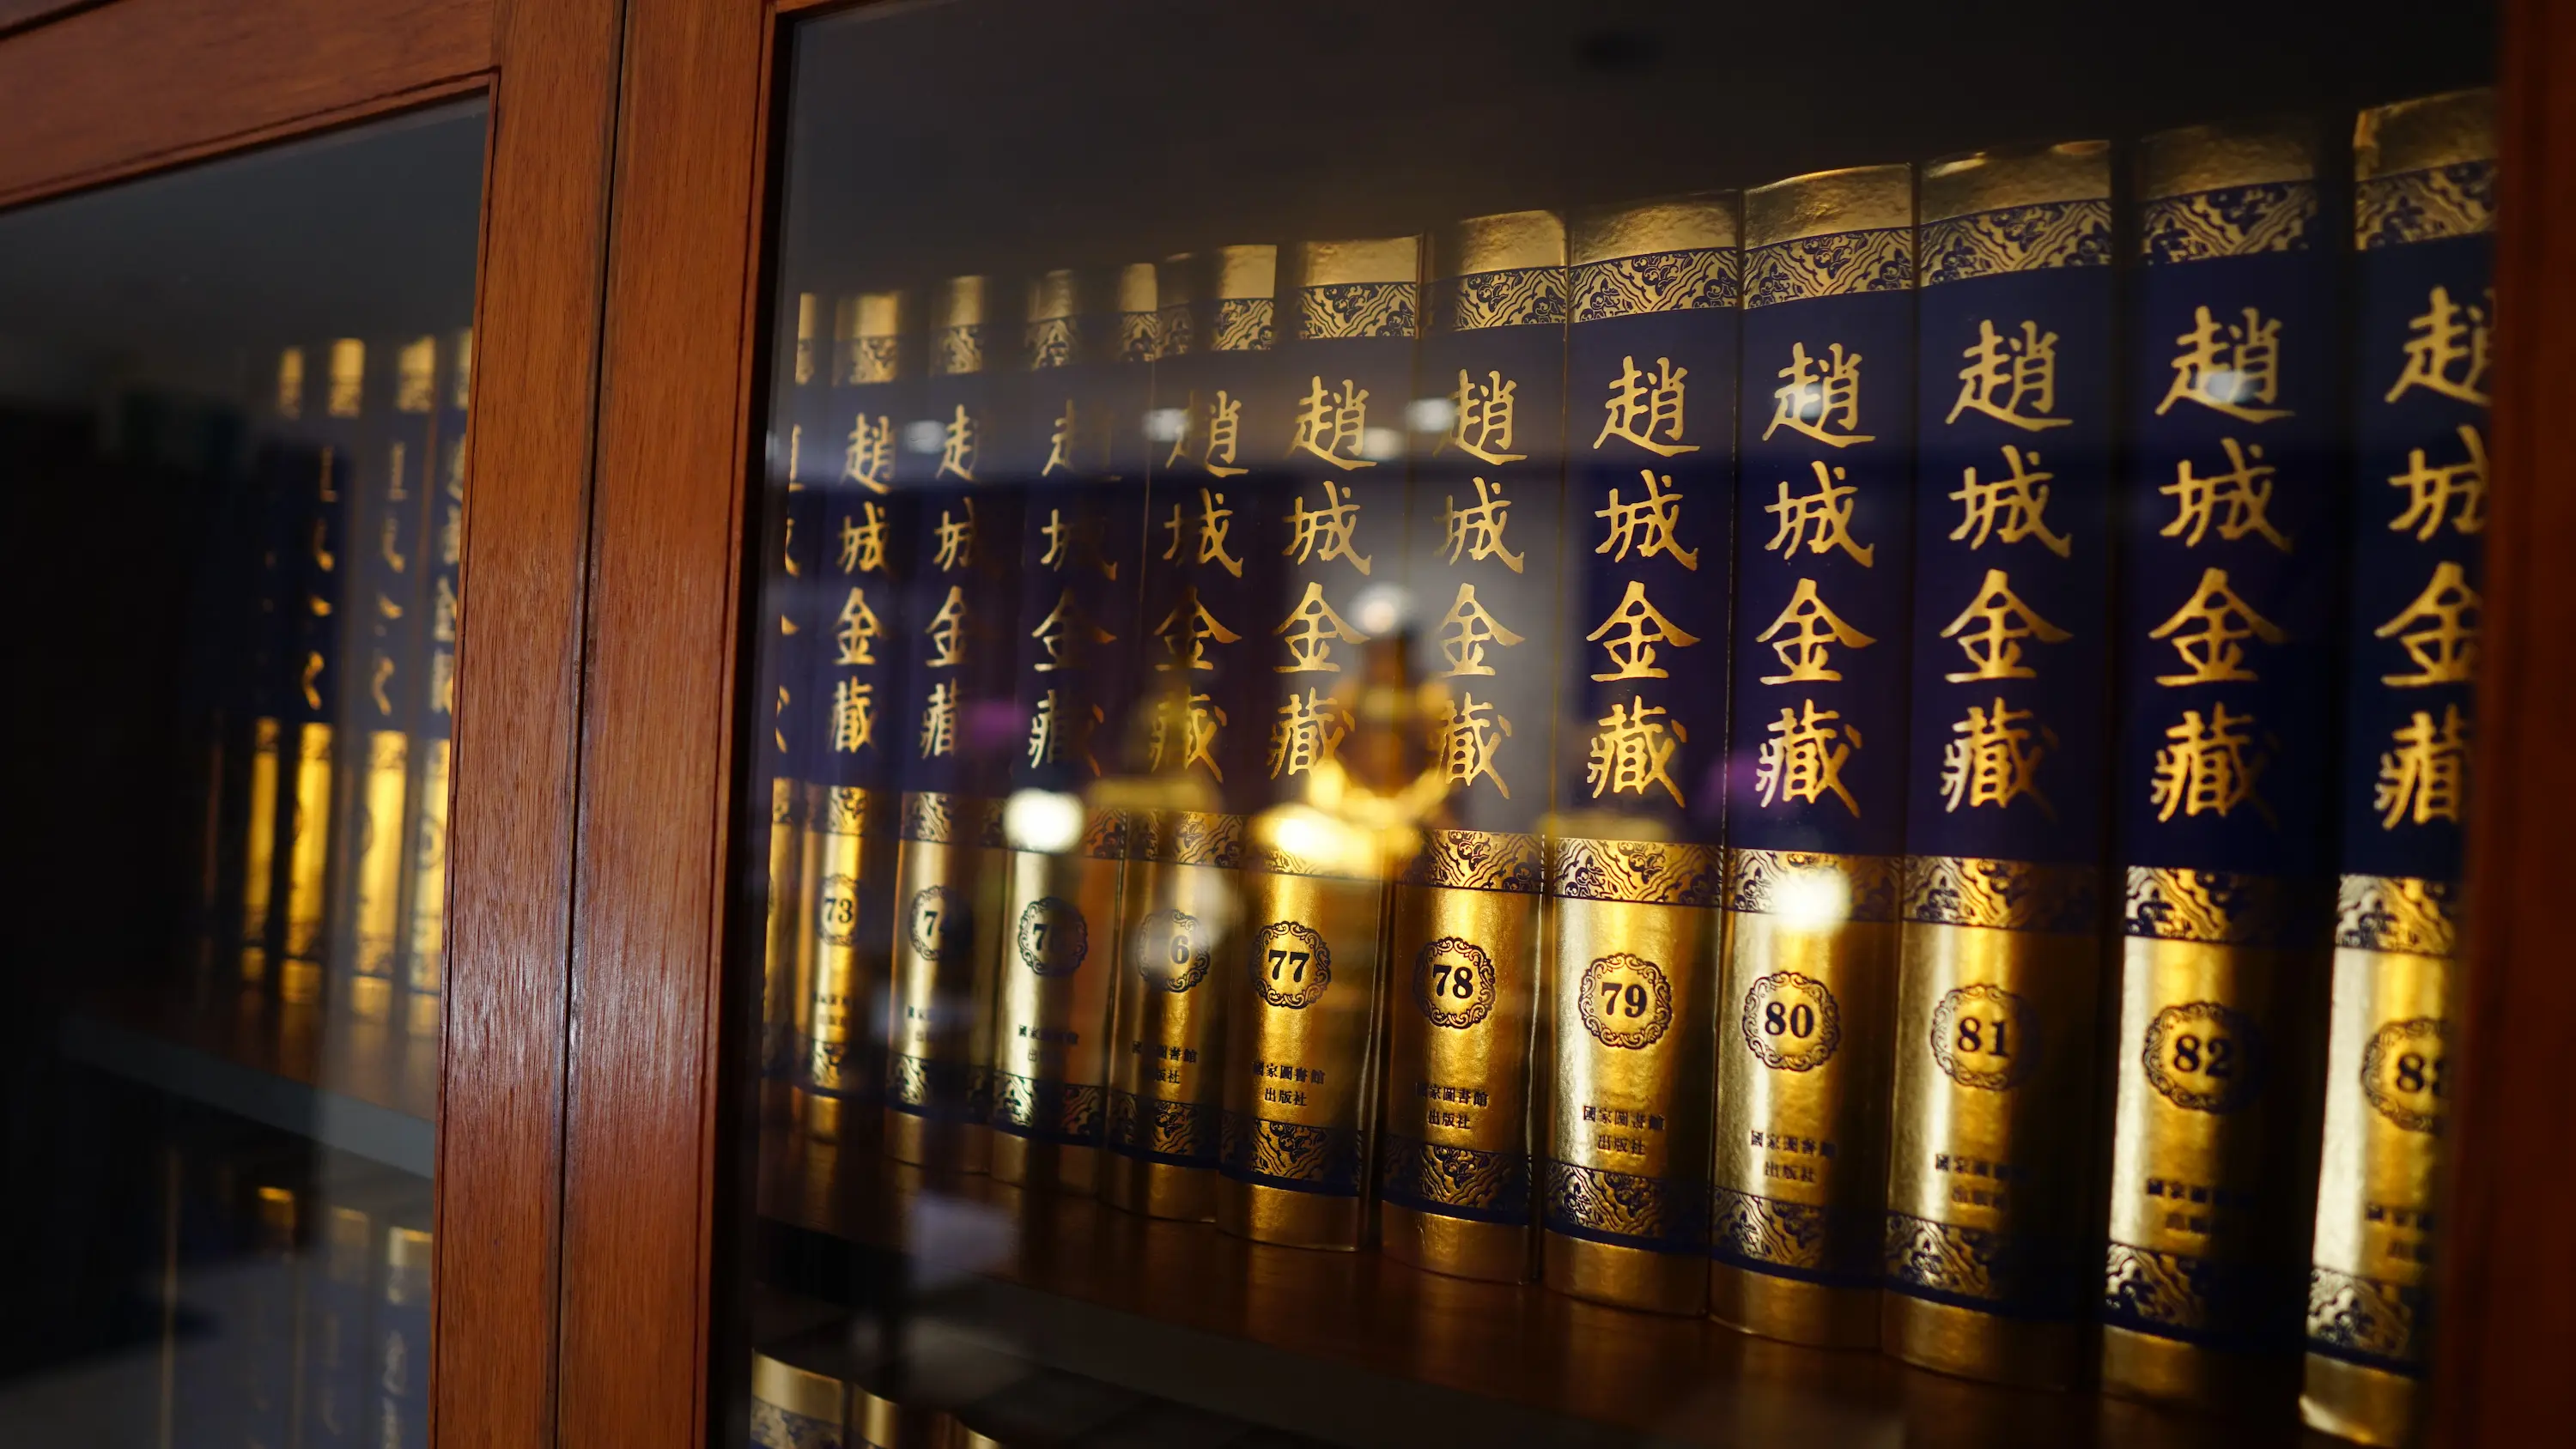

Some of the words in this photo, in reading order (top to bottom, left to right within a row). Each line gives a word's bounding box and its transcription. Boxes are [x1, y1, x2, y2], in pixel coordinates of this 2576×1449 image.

[828, 413, 897, 758] 趙城金藏
[1270, 375, 1377, 779] 趙城金藏
[1431, 369, 1528, 799] 趙城金藏
[1585, 355, 1701, 808] 趙城金藏
[1754, 342, 1877, 818] 趙城金藏
[1939, 319, 2074, 821] 趙城金藏
[2148, 306, 2295, 828] 趙城金藏
[823, 897, 853, 925] 73
[1267, 949, 1311, 984] 77
[1431, 964, 1474, 999] 78
[1600, 982, 1648, 1019] 79
[1764, 1001, 1814, 1038] 80
[1957, 1016, 2010, 1058] 81
[2172, 1034, 2233, 1078] 82
[1264, 1088, 1308, 1106] 出版社
[1426, 1109, 1472, 1130] 出版社
[1597, 1134, 1646, 1156] 出版社
